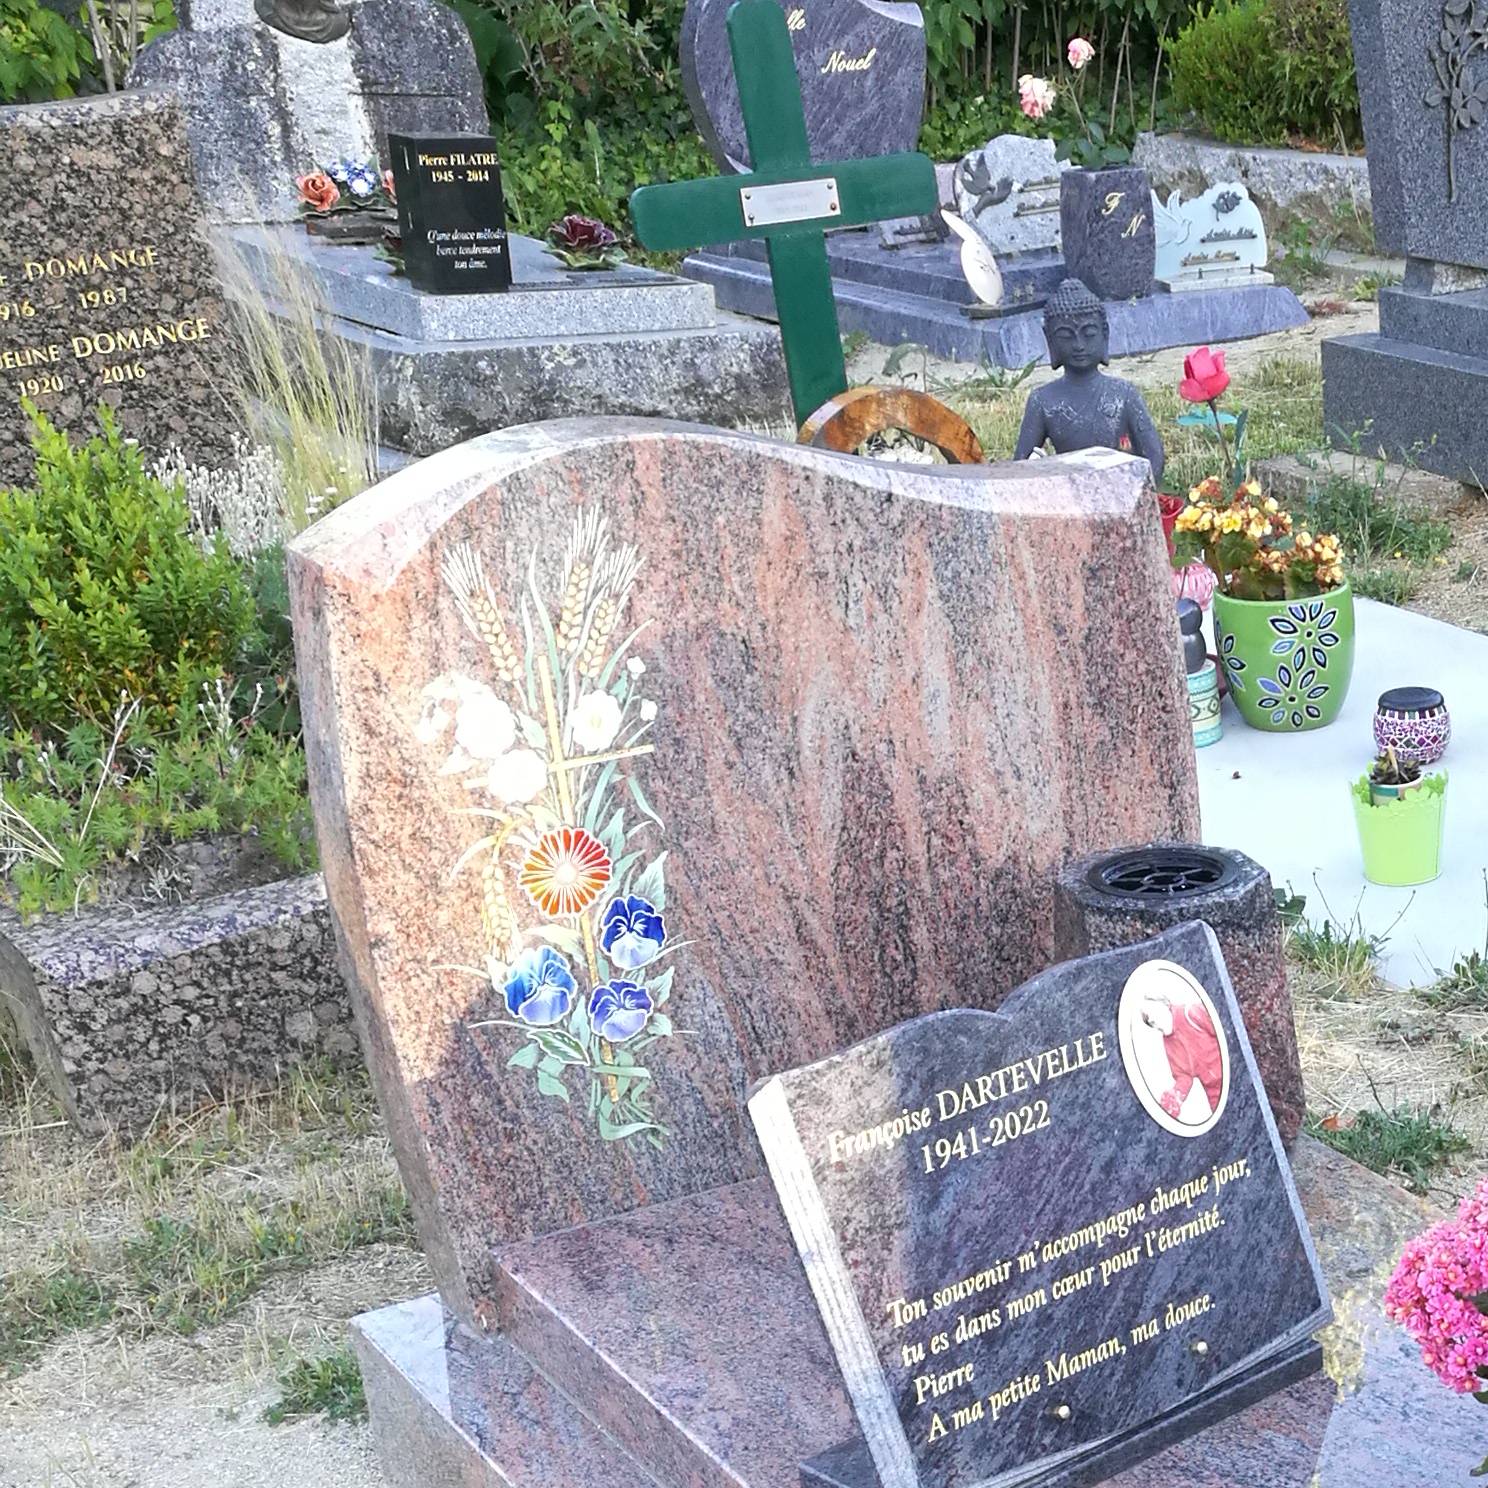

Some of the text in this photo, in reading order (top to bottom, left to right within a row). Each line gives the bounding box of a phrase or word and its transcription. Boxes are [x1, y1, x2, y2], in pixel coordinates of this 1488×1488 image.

[821, 48, 877, 73] Nouel
[418, 153, 499, 166] Pierre FILATRE
[432, 171, 454, 182] 1945
[466, 170, 490, 182] 2014
[451, 229, 476, 241] douce
[1121, 214, 1146, 239] N
[25, 245, 161, 281] DOMANGE
[454, 260, 467, 269] ton
[79, 287, 128, 309] 1987
[71, 318, 211, 358] DOMANGE
[18, 376, 64, 397] 1920
[101, 362, 146, 384] 2016
[826, 1032, 1107, 1164] Françoise DARTEVELLE
[921, 1100, 1051, 1175] 1941-2022
[886, 1158, 1252, 1329] Ton souvenir m'accompagne chaque jour,
[902, 1204, 1226, 1367] tu es dans mon cœur pour l'éternité.
[914, 1362, 975, 1406] Pierre
[927, 1293, 1217, 1443] A ma petite Maman, ma douce.
